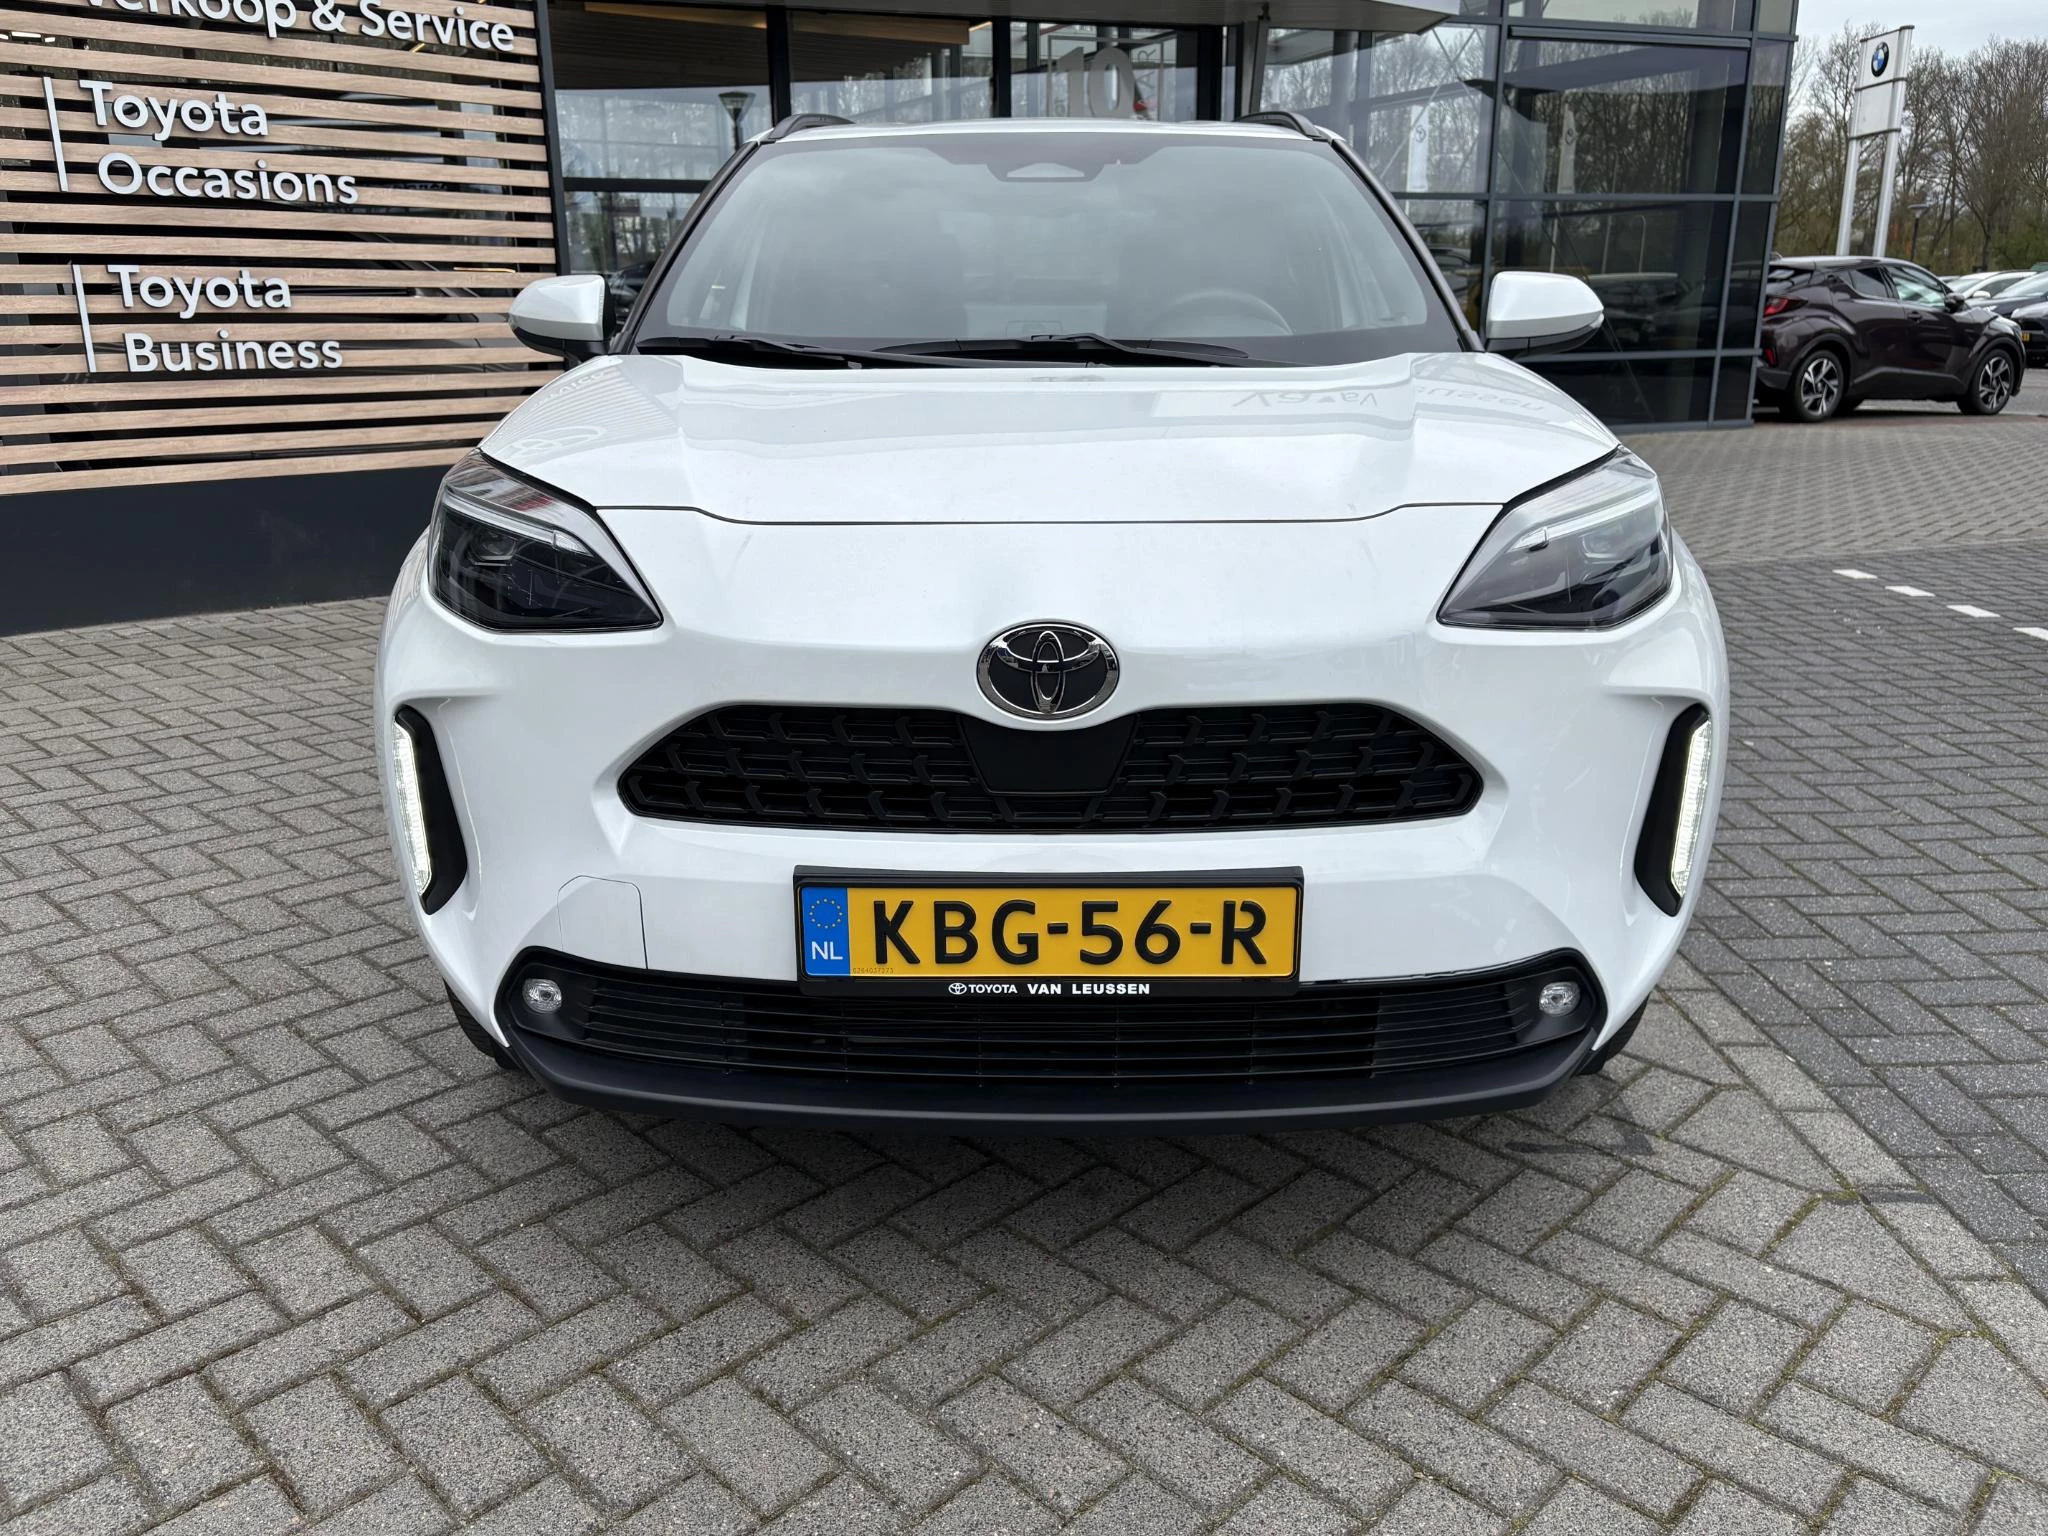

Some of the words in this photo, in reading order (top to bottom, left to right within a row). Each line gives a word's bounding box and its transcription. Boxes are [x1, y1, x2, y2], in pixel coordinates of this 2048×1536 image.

[312, 0, 345, 32] &
[360, 0, 515, 51] Service
[80, 80, 269, 141] Toyota
[98, 152, 359, 204] Occasions
[108, 265, 292, 319] Toyota
[124, 330, 343, 372] Business
[812, 942, 843, 961] NL
[873, 900, 1267, 965] KBG-56-R
[968, 984, 1018, 994] TOYOTA
[1027, 983, 1062, 995] VAN
[1072, 983, 1150, 995] LEUSSEN
